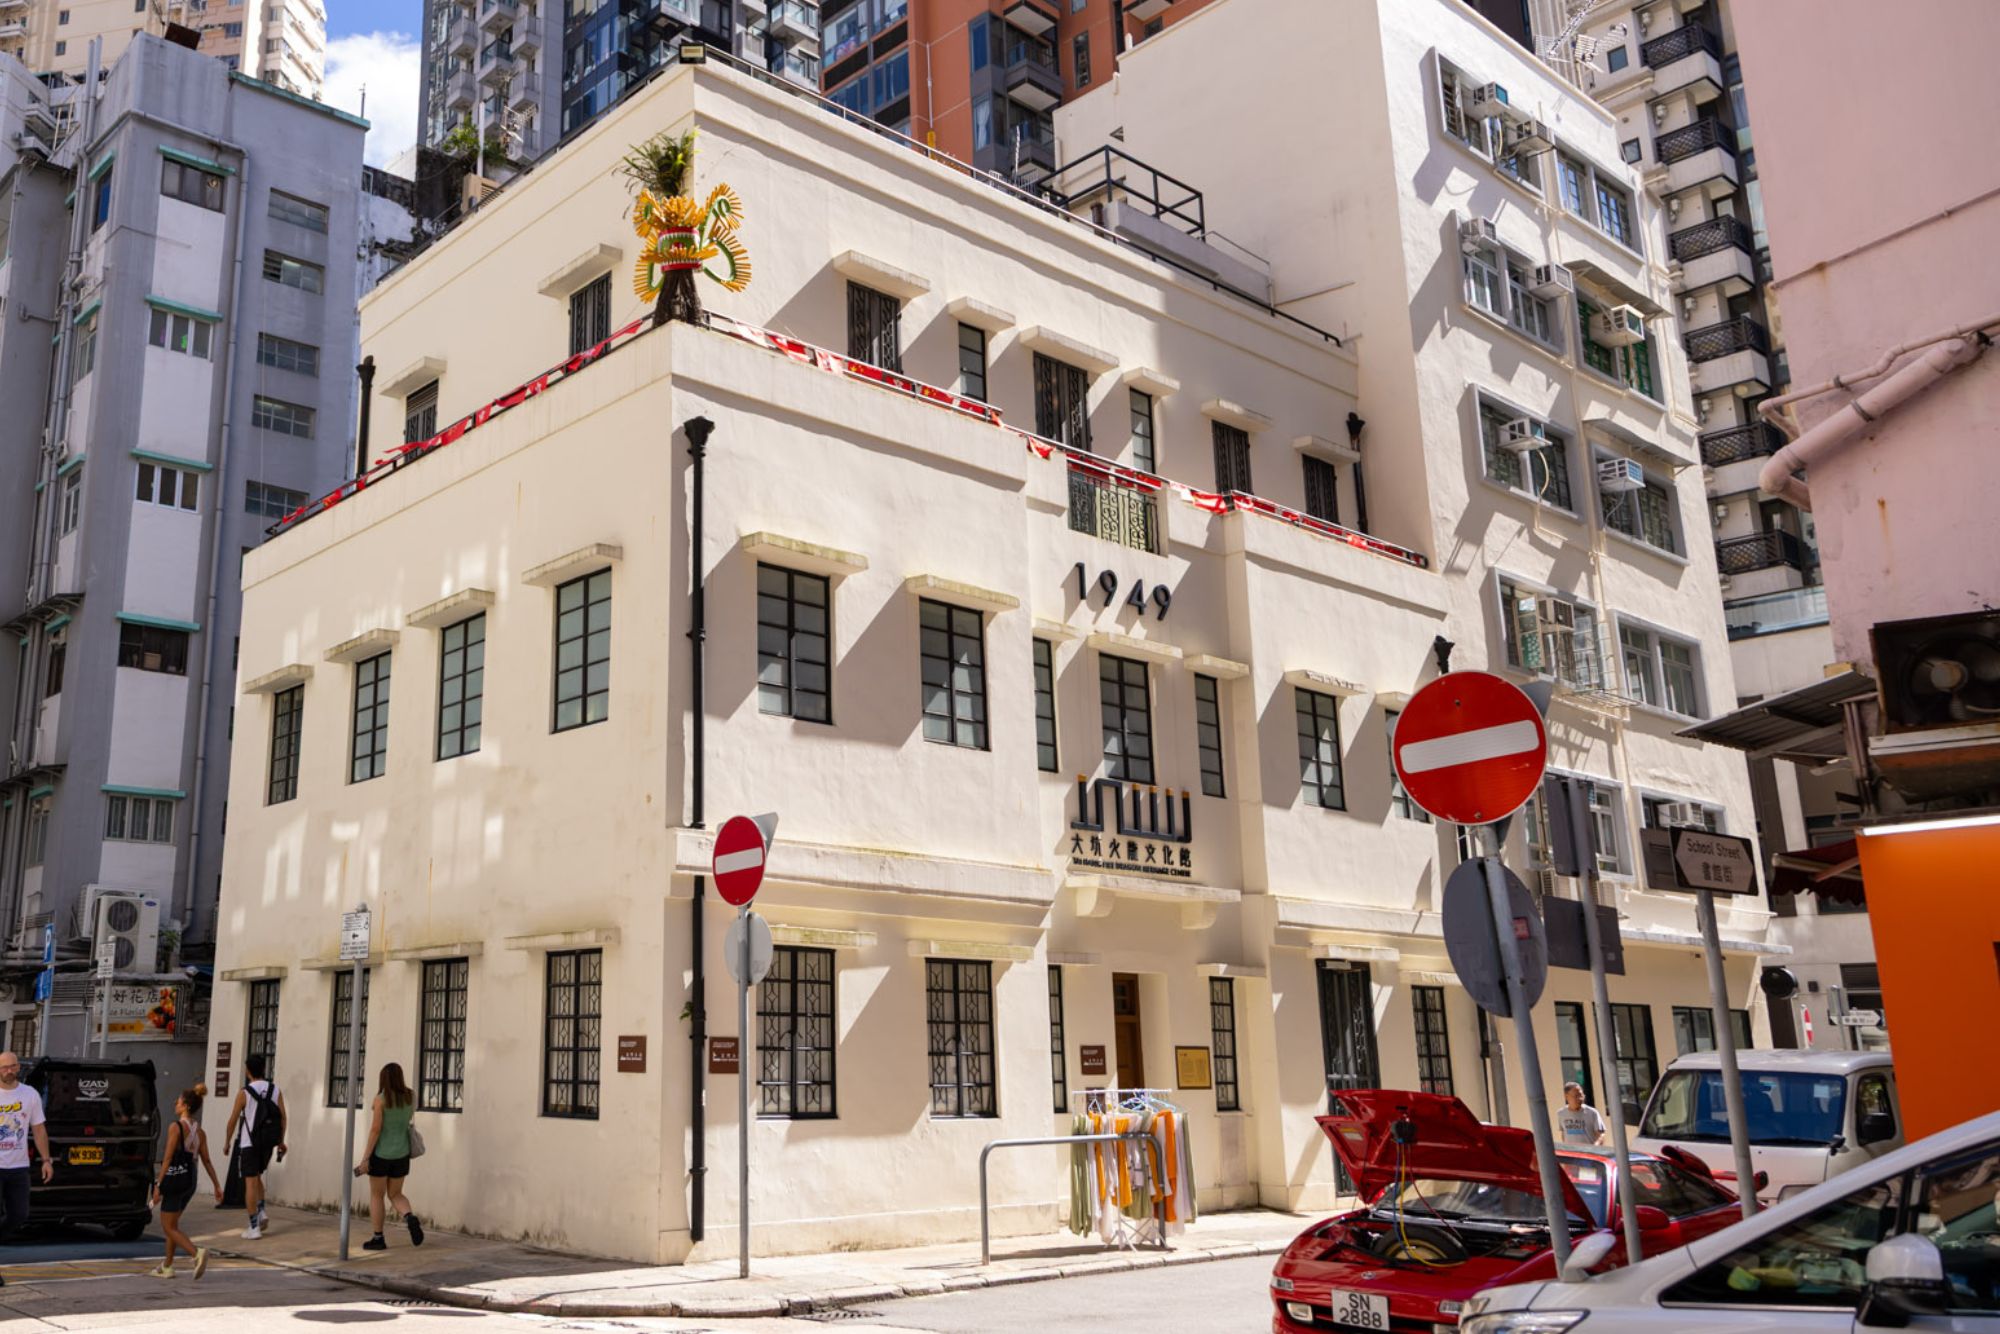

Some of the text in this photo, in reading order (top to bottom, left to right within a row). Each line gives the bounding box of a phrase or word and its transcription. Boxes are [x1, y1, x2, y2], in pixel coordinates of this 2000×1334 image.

[1074, 562, 1172, 621] 1949
[1686, 838, 1742, 860] School Street
[1348, 1293, 1371, 1311] SN
[1339, 1307, 1382, 1328] 2888
